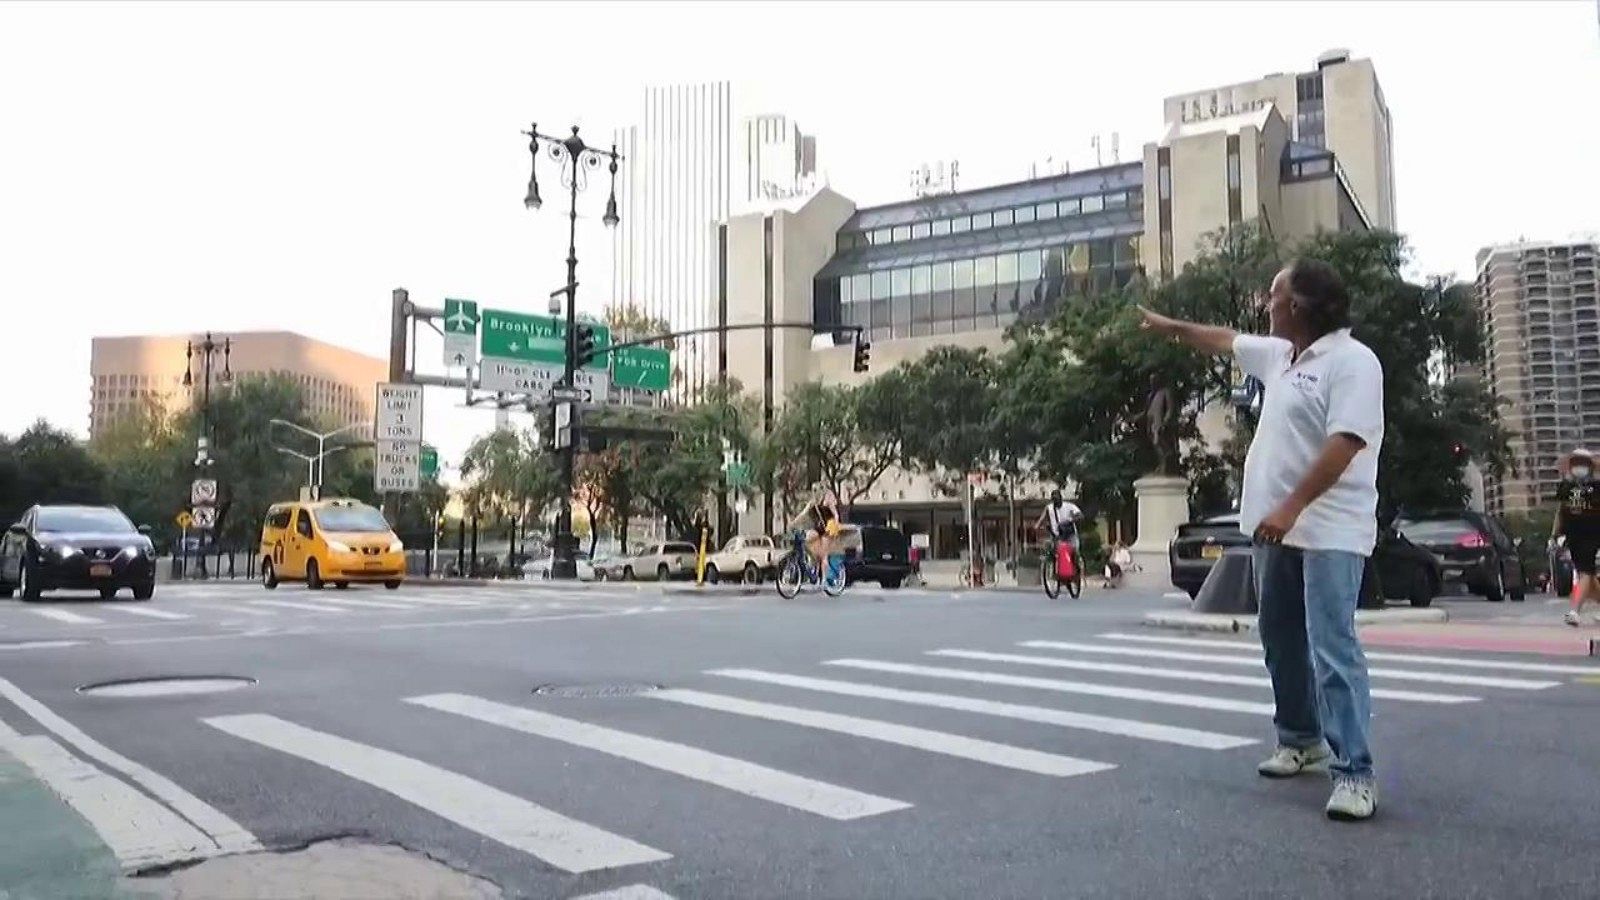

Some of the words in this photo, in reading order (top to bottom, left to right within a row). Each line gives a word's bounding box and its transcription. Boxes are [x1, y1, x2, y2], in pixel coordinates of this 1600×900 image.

[490, 316, 552, 337] Brooklyn
[640, 358, 665, 370] Drive
[514, 379, 545, 391] CARS
[382, 388, 418, 399] WEIGHT
[387, 400, 411, 410] LIMIT
[396, 413, 404, 424] 3
[387, 426, 412, 436] TONS
[392, 441, 406, 451] NO
[379, 453, 417, 465] TRUCKS
[390, 465, 405, 476] OR
[380, 477, 415, 488] BUSES
